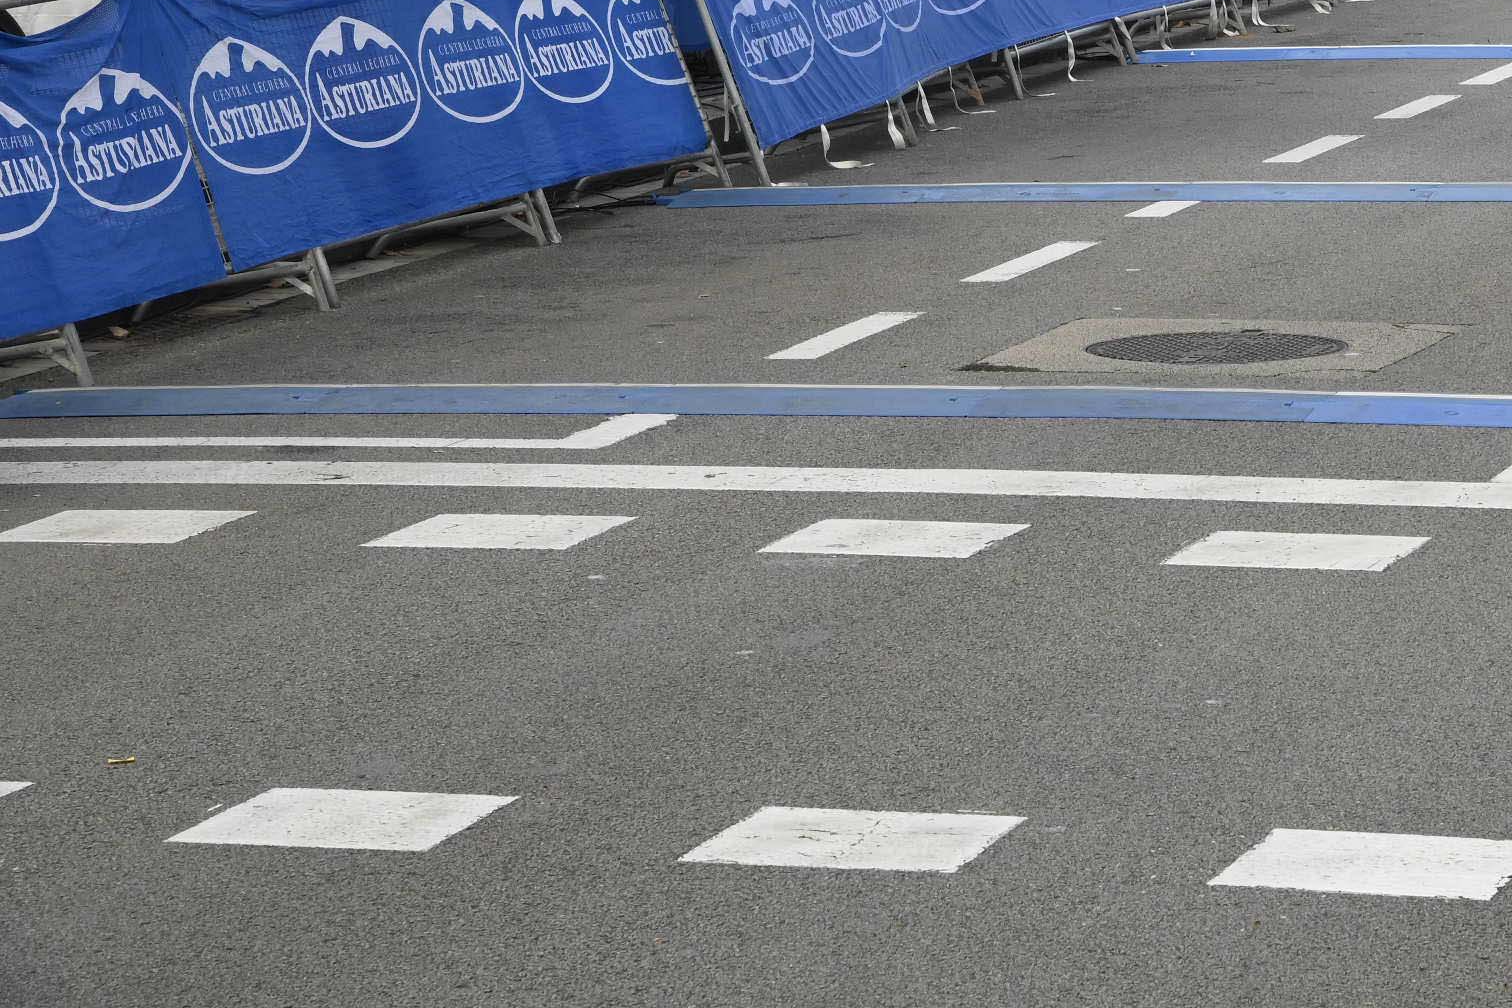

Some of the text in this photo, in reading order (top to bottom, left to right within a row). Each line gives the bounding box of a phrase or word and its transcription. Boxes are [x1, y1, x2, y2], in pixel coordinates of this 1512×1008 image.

[523, 32, 609, 78] ASTURIANA
[616, 16, 676, 61] ASTUR
[326, 53, 400, 79] CENTRAL LECHERA
[428, 47, 520, 97] ASTURIANA
[213, 77, 290, 102] CENTRAL LECHERA
[315, 71, 416, 123] ASTURIANA
[81, 118, 121, 137] CENTRAL
[202, 94, 306, 147] ASTURIANA
